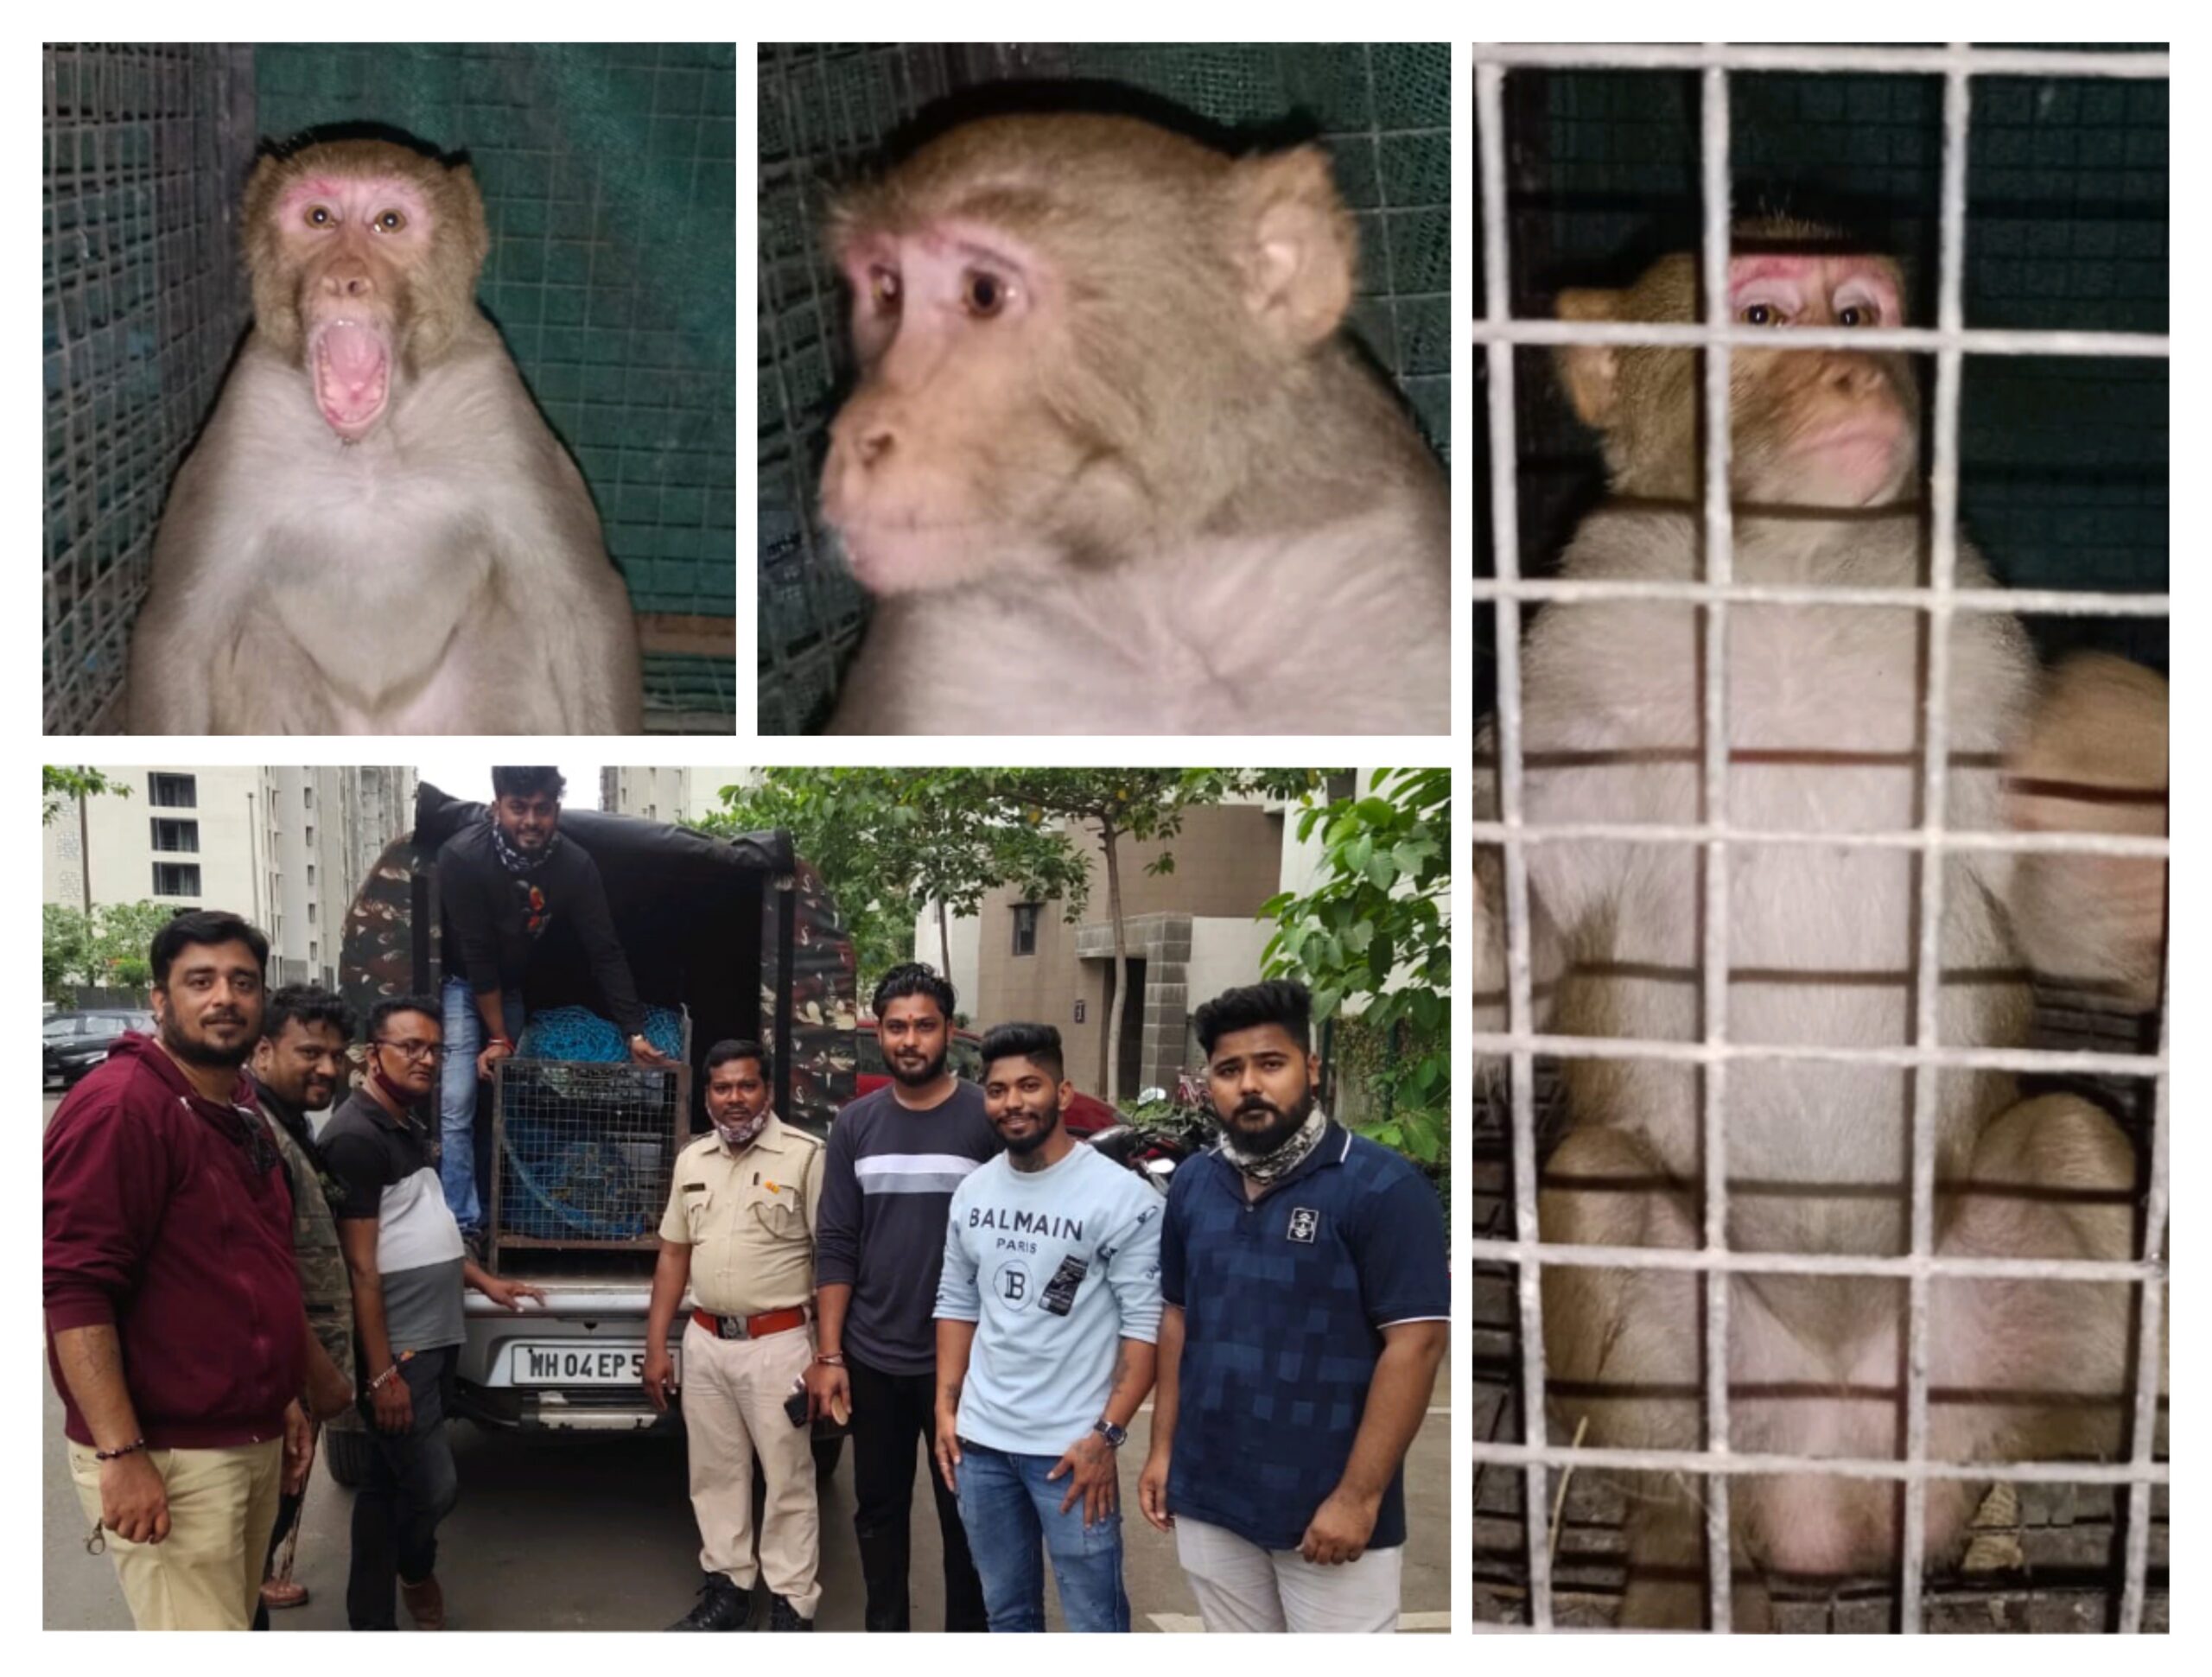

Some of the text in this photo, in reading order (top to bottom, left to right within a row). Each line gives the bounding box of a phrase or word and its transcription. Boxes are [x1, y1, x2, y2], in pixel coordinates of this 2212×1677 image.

[969, 1207, 1083, 1242] BALMAIN
[996, 1237, 1037, 1255] PARIS
[530, 1352, 558, 1378] MH
[564, 1353, 593, 1378] 04
[598, 1354, 626, 1378] EP
